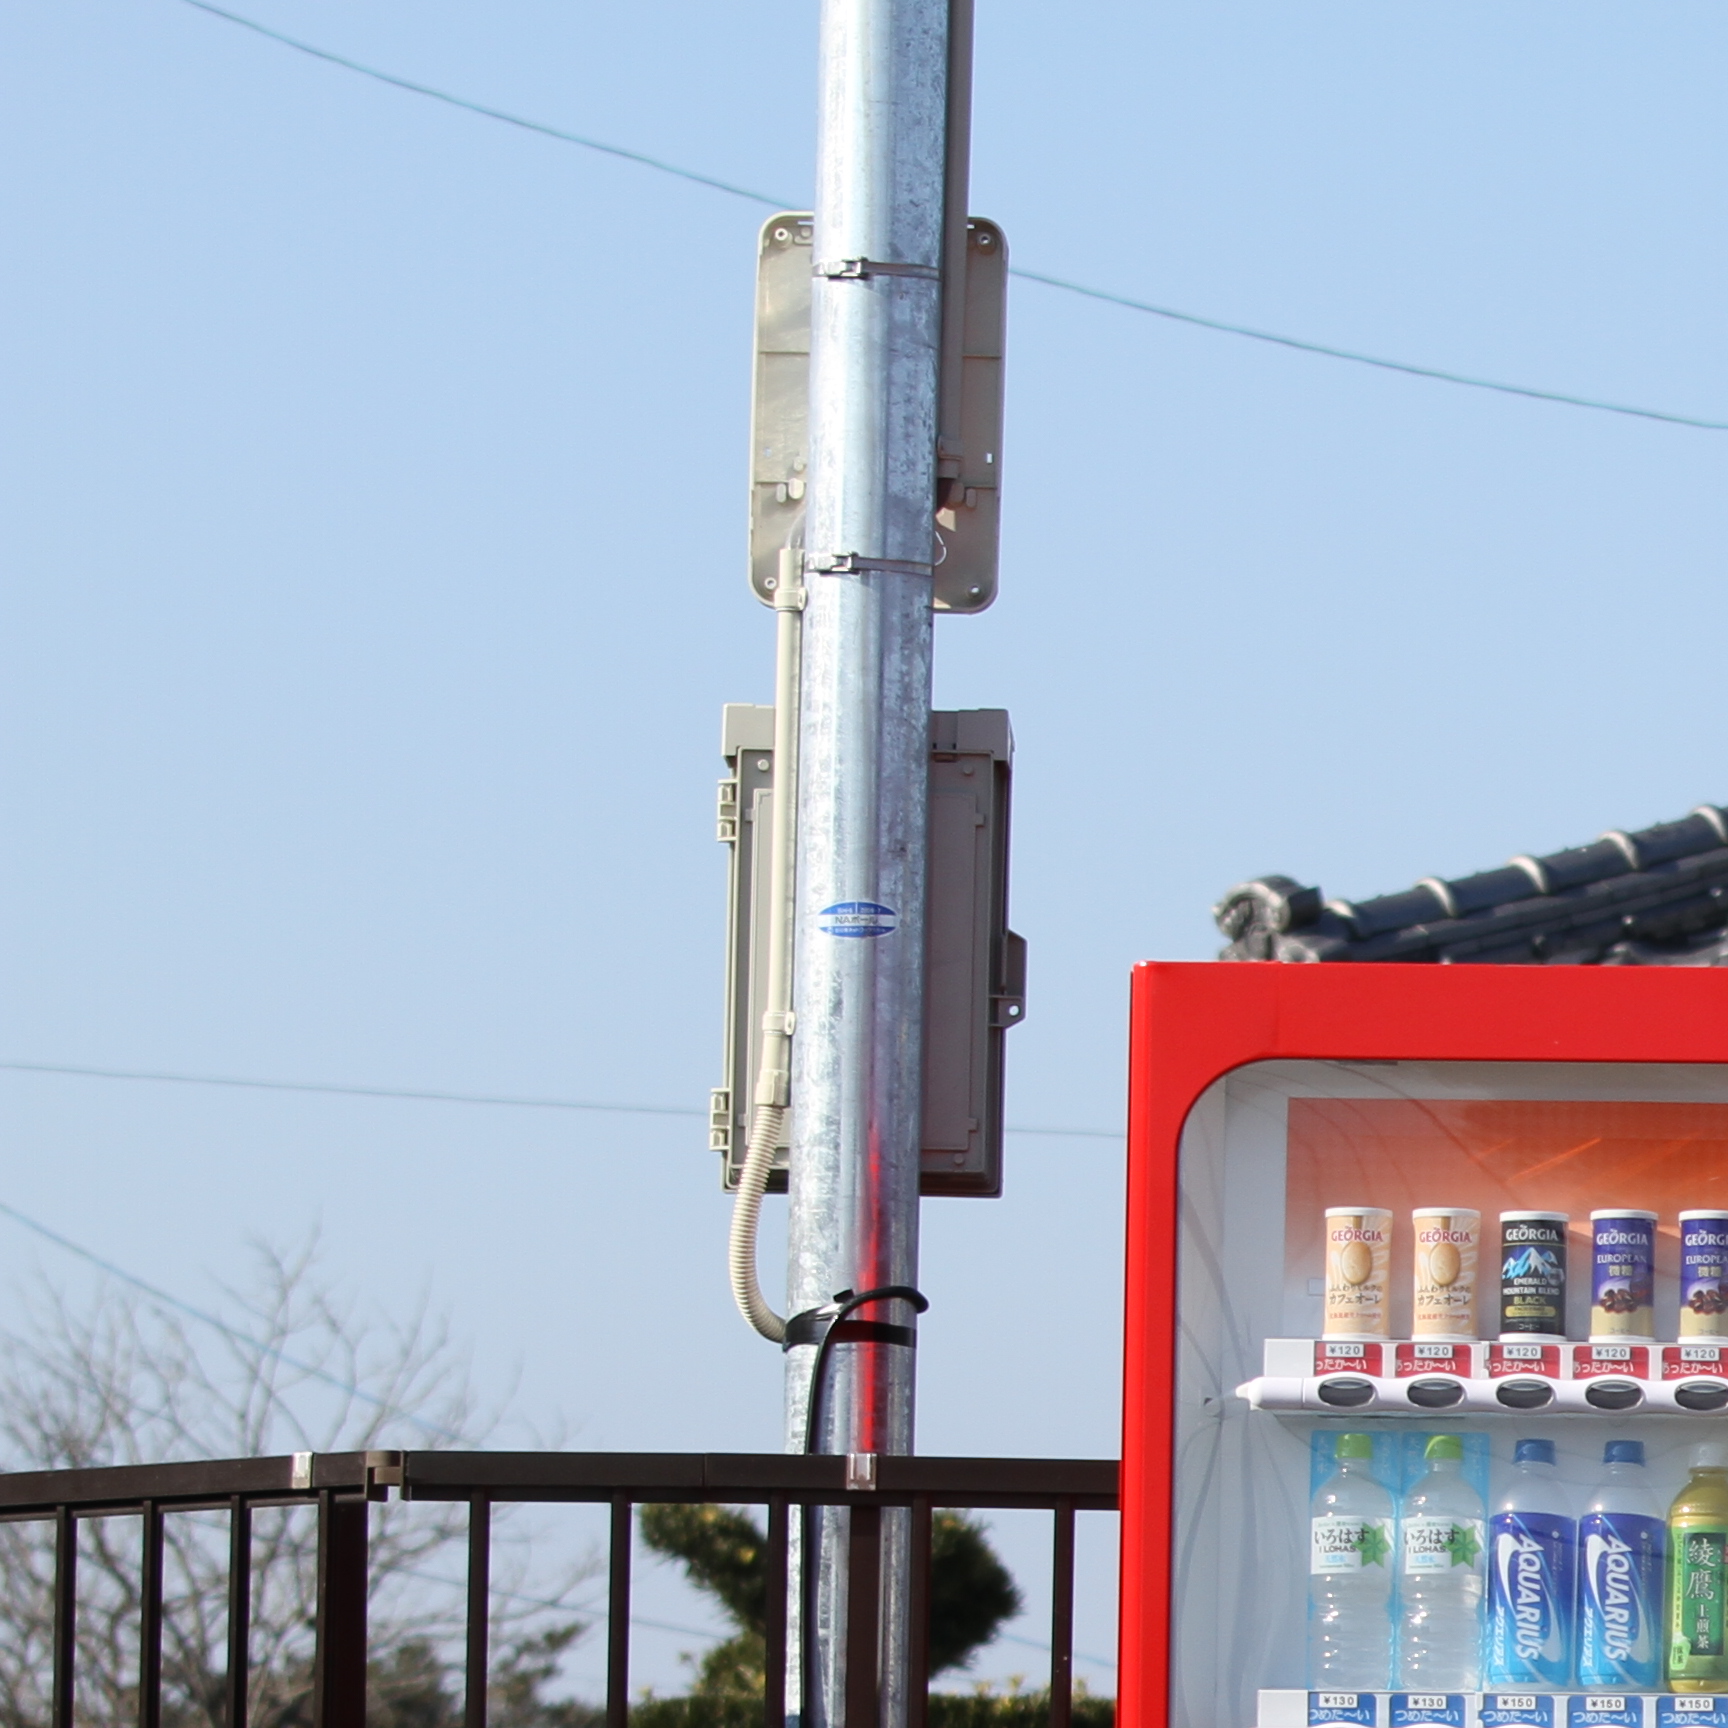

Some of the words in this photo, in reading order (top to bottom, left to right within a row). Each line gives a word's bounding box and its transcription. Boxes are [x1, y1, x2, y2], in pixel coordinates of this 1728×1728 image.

[1596, 1254, 1647, 1263] EUROPEAN
[1328, 1346, 1361, 1356] ¥120
[1417, 1347, 1450, 1356] ¥120
[1506, 1347, 1539, 1357] ¥120
[1594, 1348, 1627, 1358] ¥120
[1683, 1349, 1717, 1359] ¥120
[1314, 1528, 1369, 1544] いろはす
[1404, 1528, 1460, 1544] いろはす
[1685, 1537, 1717, 1600] 綾鷹
[1514, 1533, 1545, 1662] AQUARIUS
[1603, 1533, 1633, 1662] AQUARIUS
[1323, 1696, 1355, 1706] ¥130
[1412, 1697, 1444, 1707] ¥130
[1501, 1697, 1533, 1708] ¥150
[1590, 1698, 1622, 1709] ¥150
[1678, 1699, 1711, 1709] ¥150
